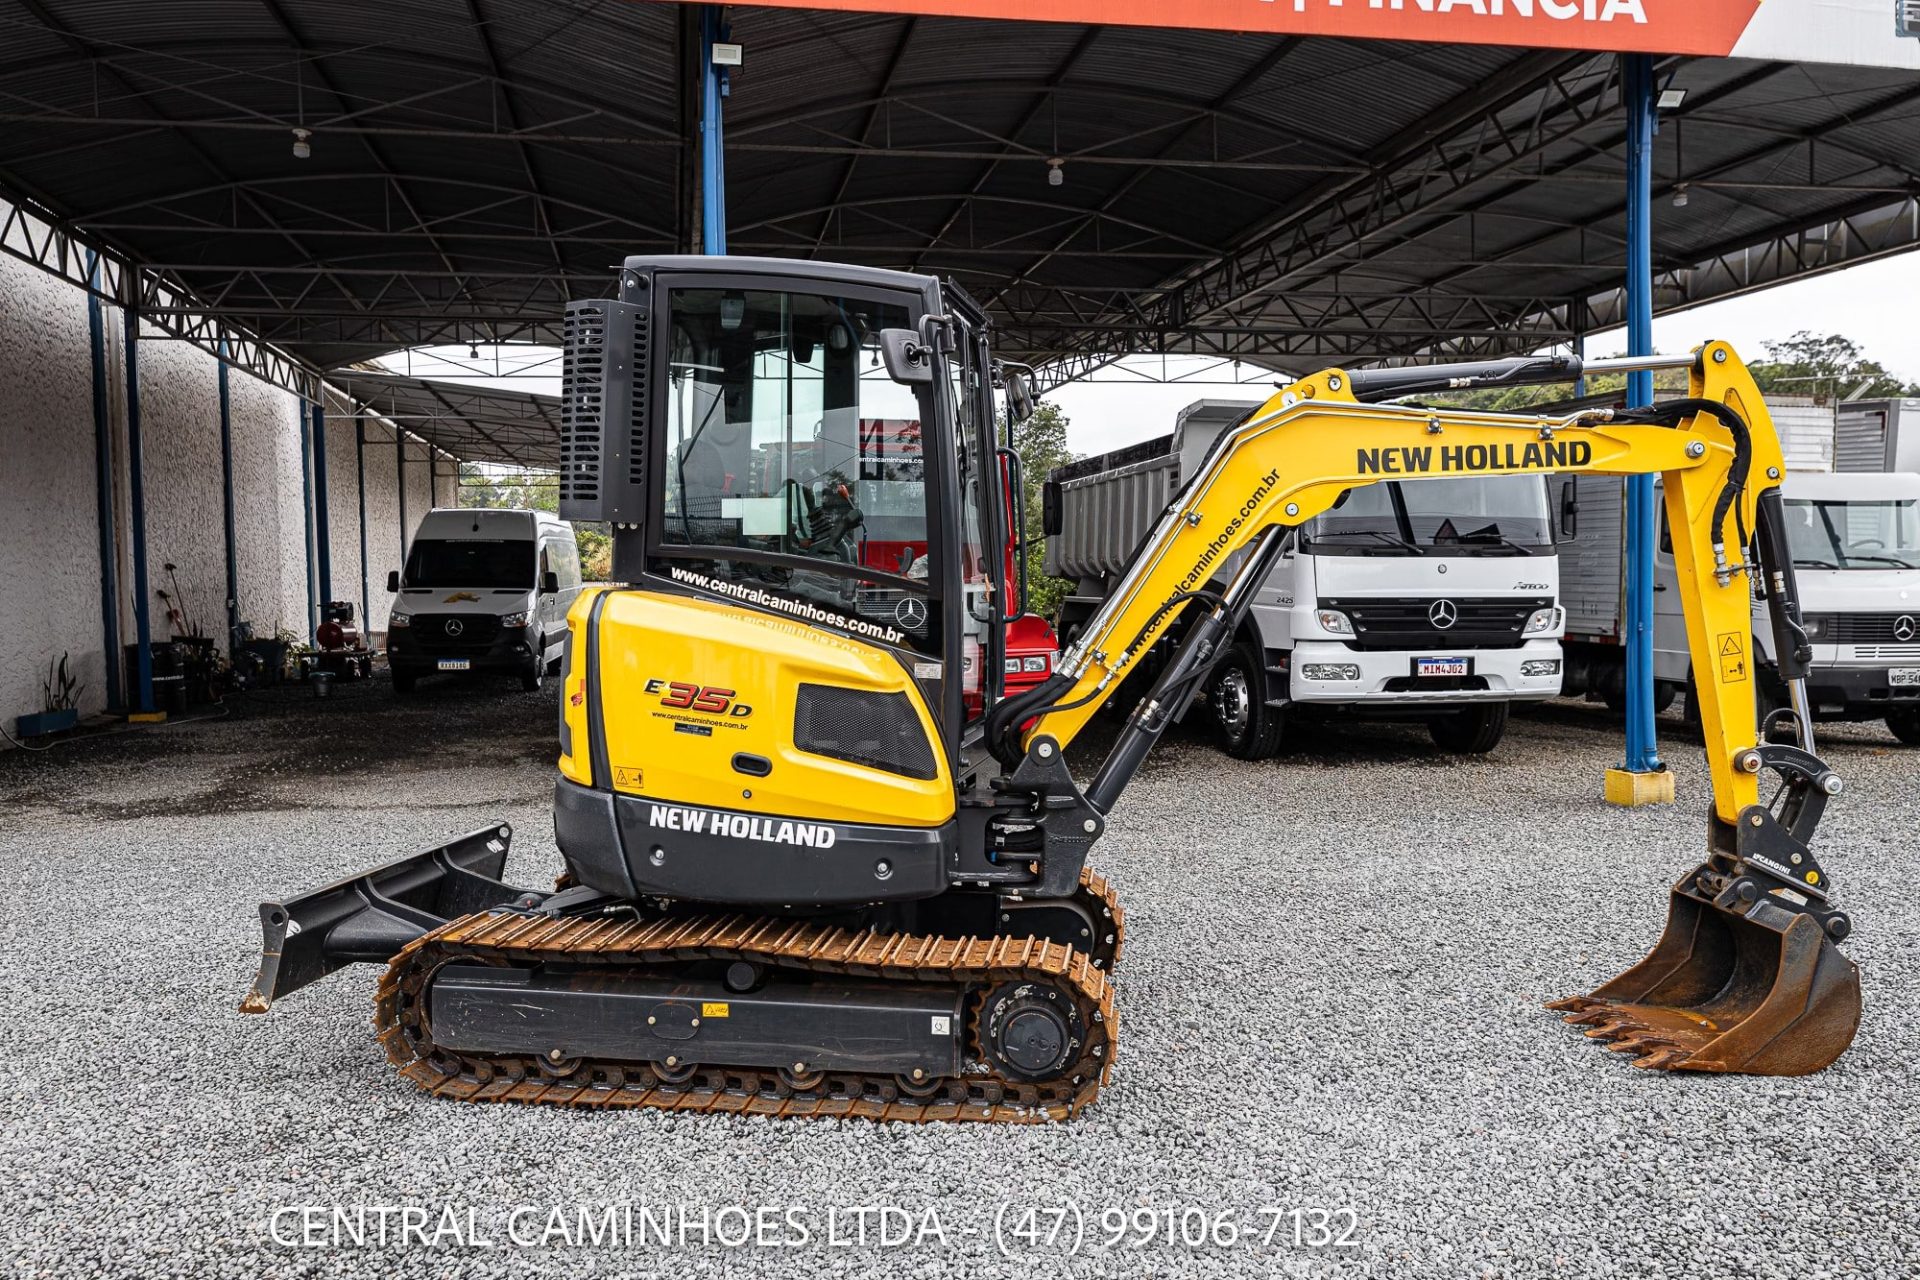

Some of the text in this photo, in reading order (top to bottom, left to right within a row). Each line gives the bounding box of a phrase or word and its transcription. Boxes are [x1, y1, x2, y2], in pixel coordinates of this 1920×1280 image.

[1357, 441, 1592, 473] NEW HOLLAND
[671, 566, 904, 644] www.centralcaminhoes.com.br
[651, 711, 749, 730] www.centralcaminhoes.com.br
[650, 805, 836, 849] NEW HOLLAND
